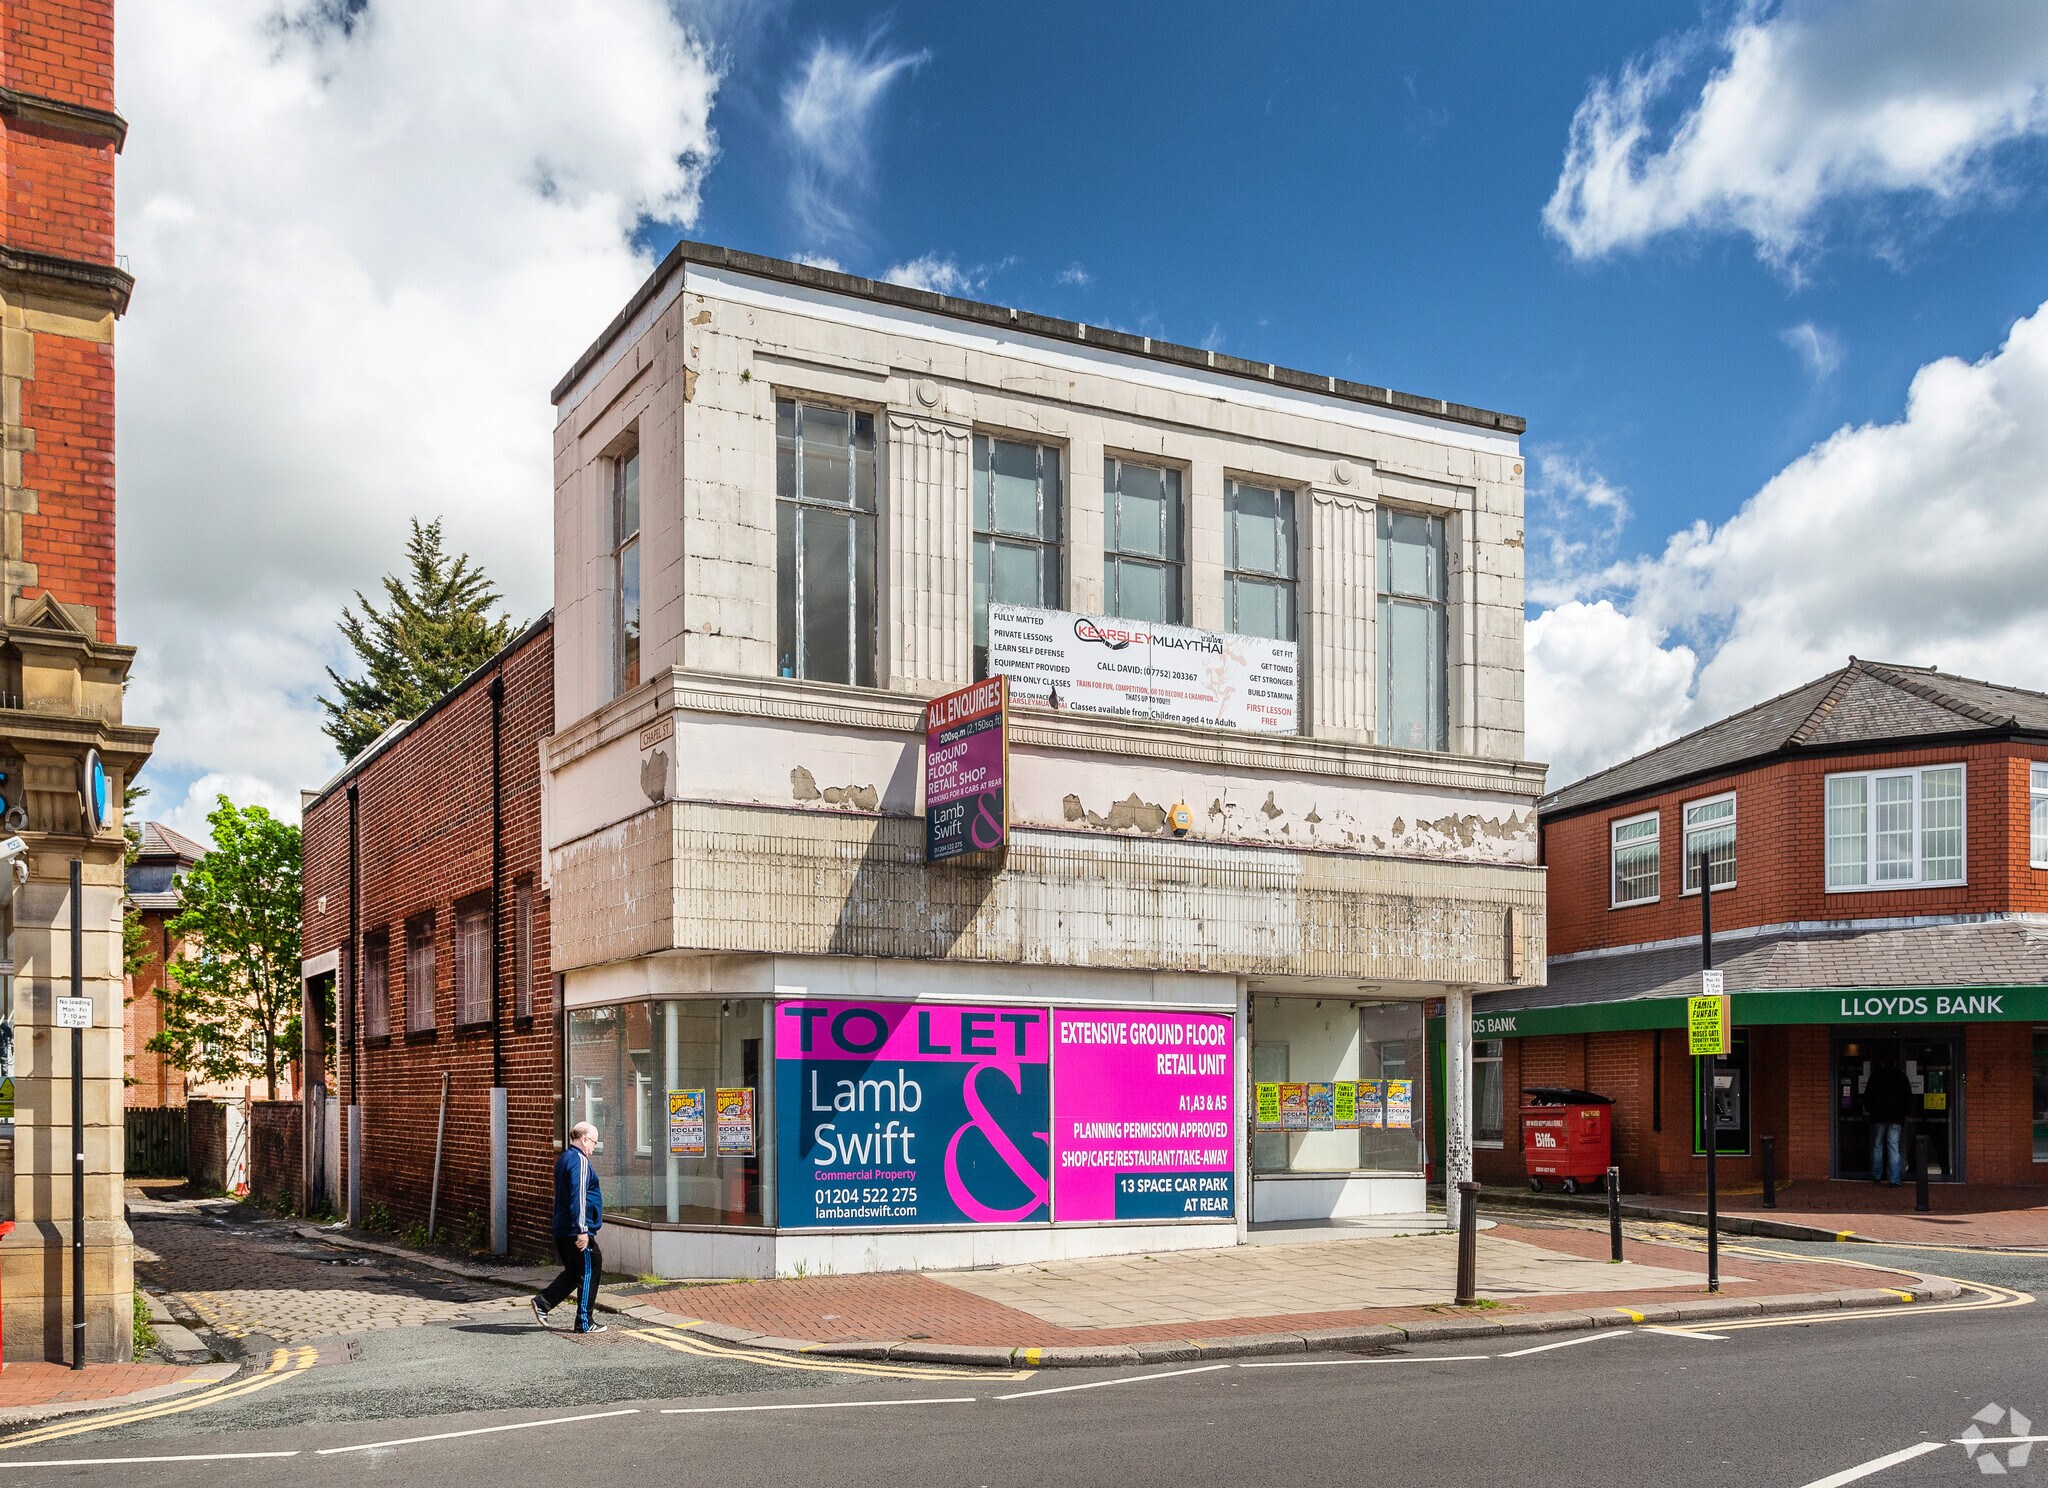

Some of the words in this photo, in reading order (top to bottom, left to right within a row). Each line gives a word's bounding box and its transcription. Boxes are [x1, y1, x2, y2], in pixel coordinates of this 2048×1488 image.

[994, 613, 1015, 622] FULLY
[1016, 616, 1043, 625] MATTED
[994, 630, 1022, 639] PRIVATE
[1023, 634, 1053, 642] LESSONS
[994, 644, 1017, 652] LEARN
[1018, 646, 1033, 654] SELF
[1035, 648, 1064, 658] DEFENSE
[1272, 649, 1283, 657] GET
[994, 659, 1035, 669] EQUIPMENT
[1036, 663, 1070, 673] PROVIDED
[1097, 662, 1115, 671] CALL
[1117, 664, 1142, 675] DAVID:
[1144, 667, 1171, 679] (07752)
[1172, 672, 1197, 682] 203367
[1273, 665, 1293, 673] TONED
[1023, 676, 1041, 684] ONLY
[1043, 678, 1071, 687] CLASSES
[1076, 680, 1091, 688] TRAIN
[1092, 681, 1102, 689] FOR
[1103, 682, 1114, 691] FUN,
[1115, 684, 1150, 695] COMPETITION,
[1151, 686, 1157, 695] OR
[1158, 687, 1164, 695] TO
[1165, 688, 1184, 698] BECOME
[1184, 690, 1188, 698] A
[1262, 677, 1293, 686] STRONGER
[1125, 693, 1140, 701] THATS
[1141, 694, 1148, 702] UP
[1248, 689, 1266, 697] BUILD
[1267, 691, 1293, 700] STAMINA
[928, 705, 946, 730] ALL
[948, 680, 1000, 722] ENQUIRIES
[1247, 704, 1265, 712] FIRST
[1267, 706, 1292, 716] LESSON
[1070, 702, 1097, 712] Classes
[1098, 705, 1131, 716] available
[1132, 709, 1149, 717] from
[1151, 711, 1180, 721] Children
[1182, 714, 1199, 725] aged
[1206, 717, 1213, 725] to
[1215, 718, 1236, 727] Adults
[1262, 717, 1277, 726] FREE
[643, 728, 661, 745] CHAPEL
[940, 729, 966, 744] 200sq.m
[928, 742, 968, 766] GROUND
[928, 761, 958, 781] FLOOR
[928, 775, 957, 795] RETAIL
[959, 766, 986, 785] SHOP
[928, 792, 949, 805] PARKING
[950, 789, 959, 799] FOR
[960, 788, 964, 796] 8
[965, 784, 979, 795] CARS
[980, 781, 987, 790] AT
[988, 777, 1002, 788] REAR
[934, 802, 964, 824] Lamb
[934, 820, 962, 841] Swift
[1694, 1001, 1716, 1009] FAMILY
[1841, 997, 1927, 1016] LLOYDS
[1936, 995, 2003, 1014] BANK
[1693, 1009, 1718, 1018] FUNFAIR
[784, 1007, 889, 1054] TO
[918, 1011, 1039, 1057] LET
[1488, 1017, 1517, 1032] BANK
[1061, 1022, 1127, 1044] EXTENSIVE
[1130, 1024, 1183, 1045] GROUND
[1186, 1024, 1226, 1046] FLOOR
[1157, 1054, 1196, 1074] RETAIL
[1199, 1054, 1226, 1075] UNIT
[811, 1069, 922, 1112] Lamb
[670, 1098, 694, 1114] CIRCUS
[718, 1097, 742, 1112] CIRCUS
[1179, 1096, 1205, 1112] A1,A3
[1207, 1096, 1214, 1110] &
[1215, 1096, 1227, 1110] A5
[1073, 1123, 1121, 1139] PLANNING
[1123, 1123, 1179, 1138] PERMISSION
[1180, 1122, 1228, 1138] APPROVED
[814, 1121, 916, 1166] Swift
[1535, 1133, 1556, 1147] Biffa
[1062, 1150, 1228, 1167] SHOP/CAFE/RESTAURANT/TAKE-AWAY
[814, 1170, 873, 1181] Commercial
[875, 1169, 916, 1182] Property
[1121, 1179, 1135, 1192] 13
[1137, 1179, 1172, 1192] SPACE
[1175, 1178, 1197, 1192] CAR
[1199, 1178, 1228, 1191] PARK
[815, 1189, 859, 1204] 01204
[862, 1189, 889, 1202] 522
[892, 1187, 917, 1202] 275
[1184, 1198, 1199, 1211] AT
[1200, 1197, 1228, 1211] REAR
[815, 1205, 917, 1219] lambandswift.com
